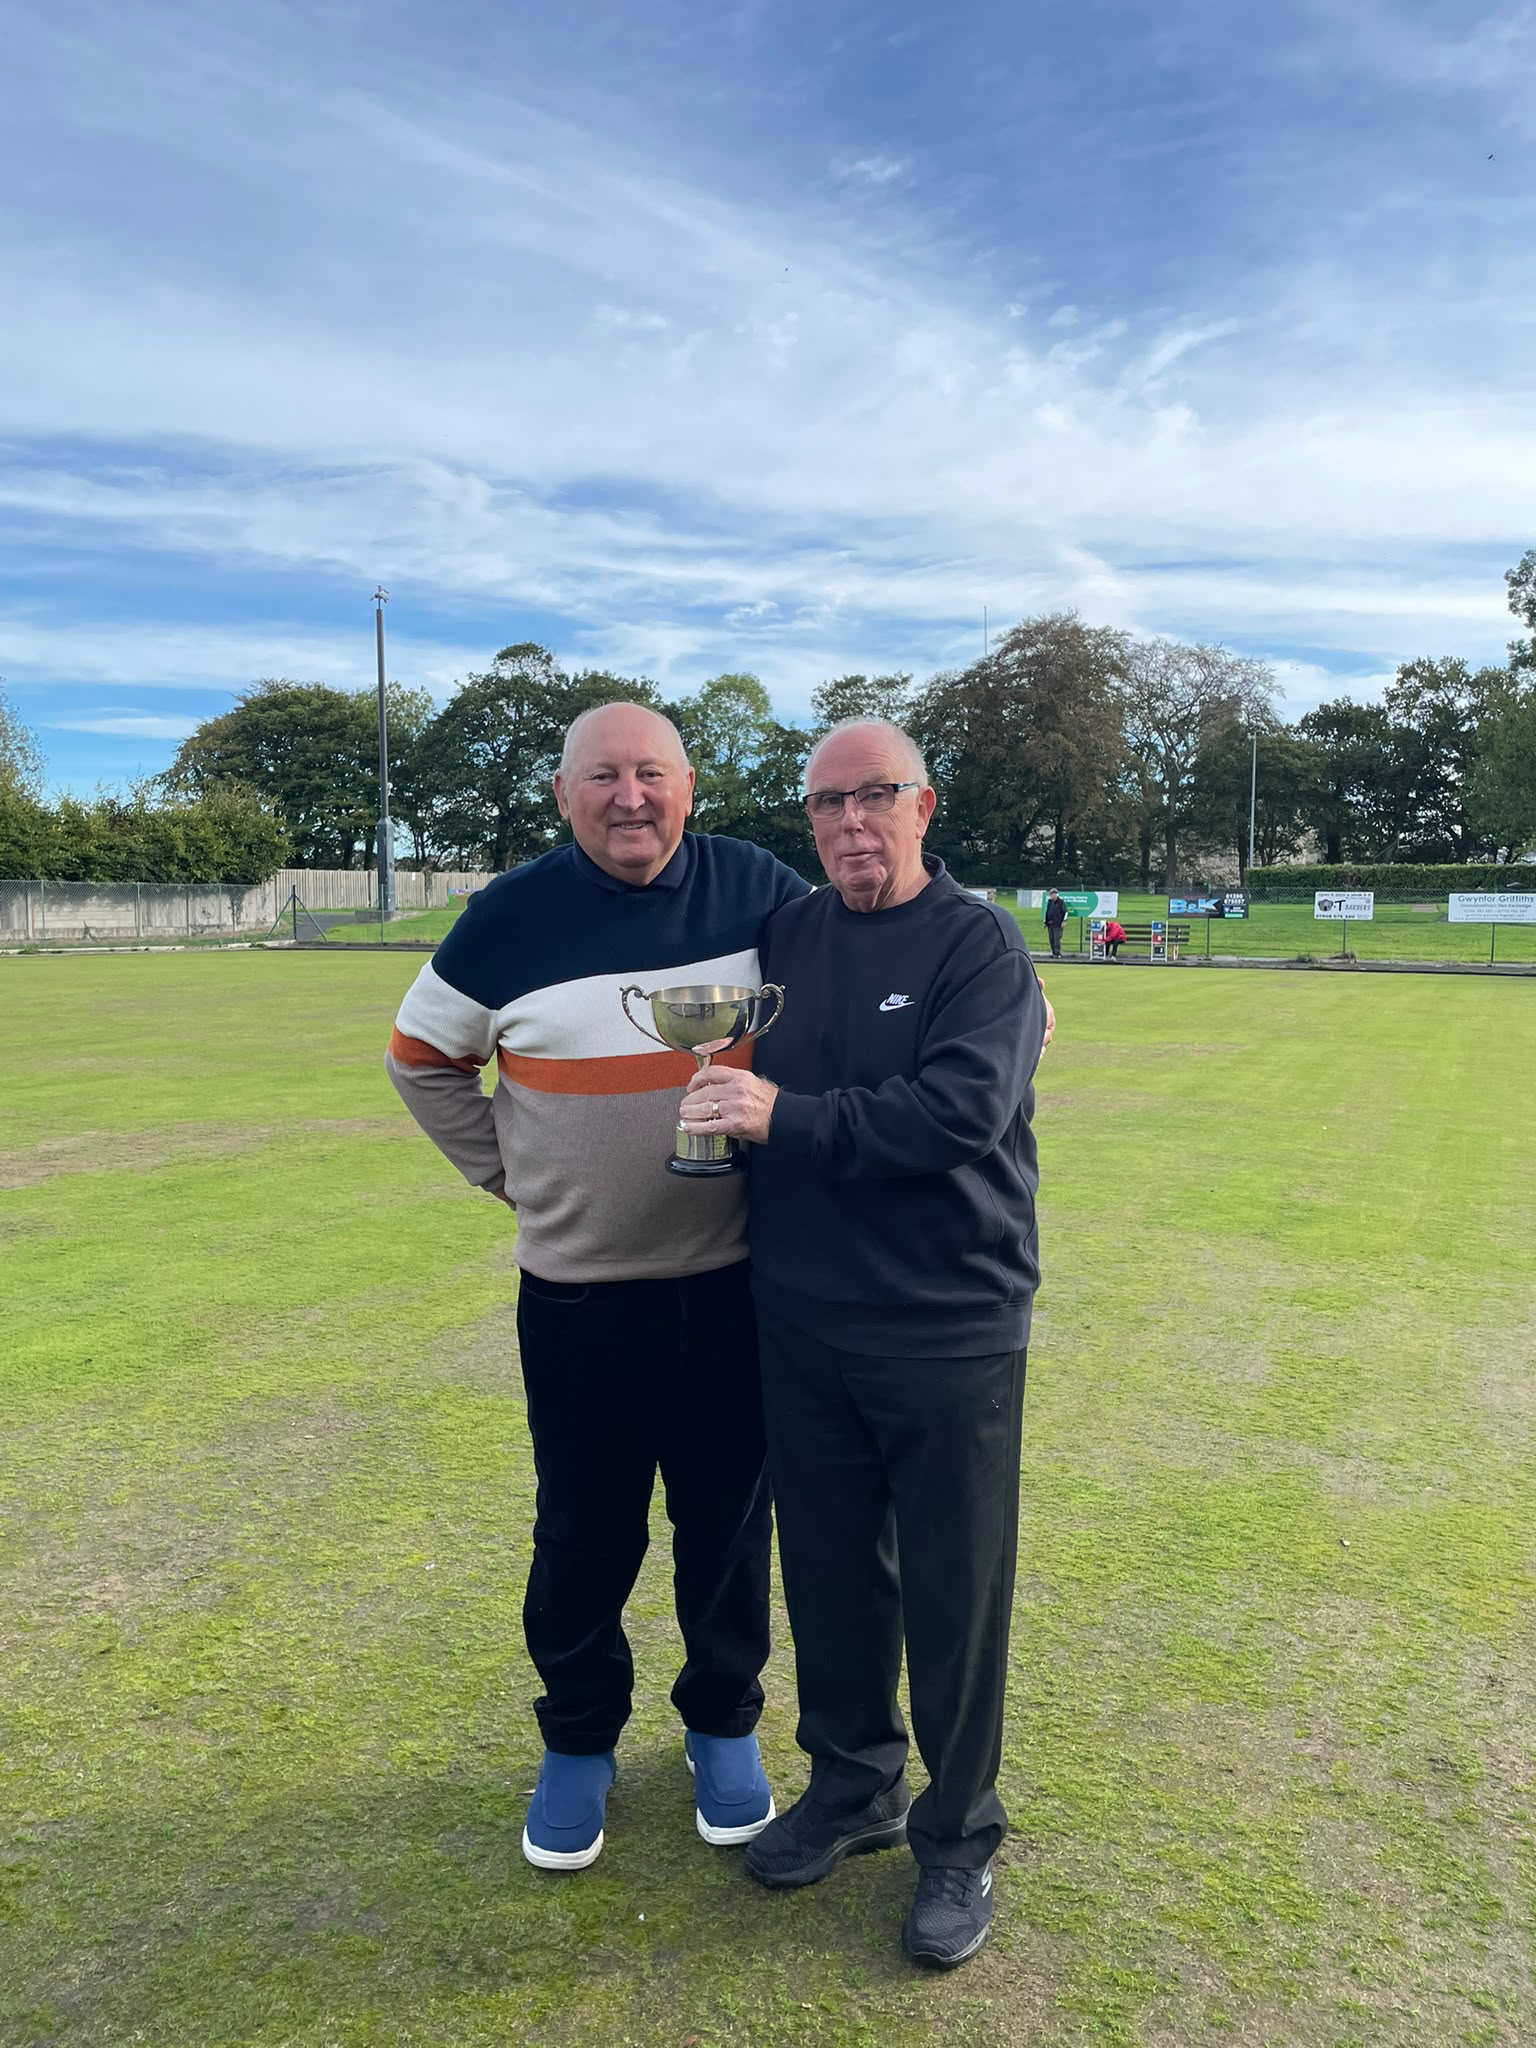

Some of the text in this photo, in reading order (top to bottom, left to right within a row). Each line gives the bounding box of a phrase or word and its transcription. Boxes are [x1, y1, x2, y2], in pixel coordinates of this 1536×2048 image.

[1458, 895, 1495, 903] Gwynfor
[1170, 898, 1220, 913] B&K
[886, 993, 910, 1005] NIKE
